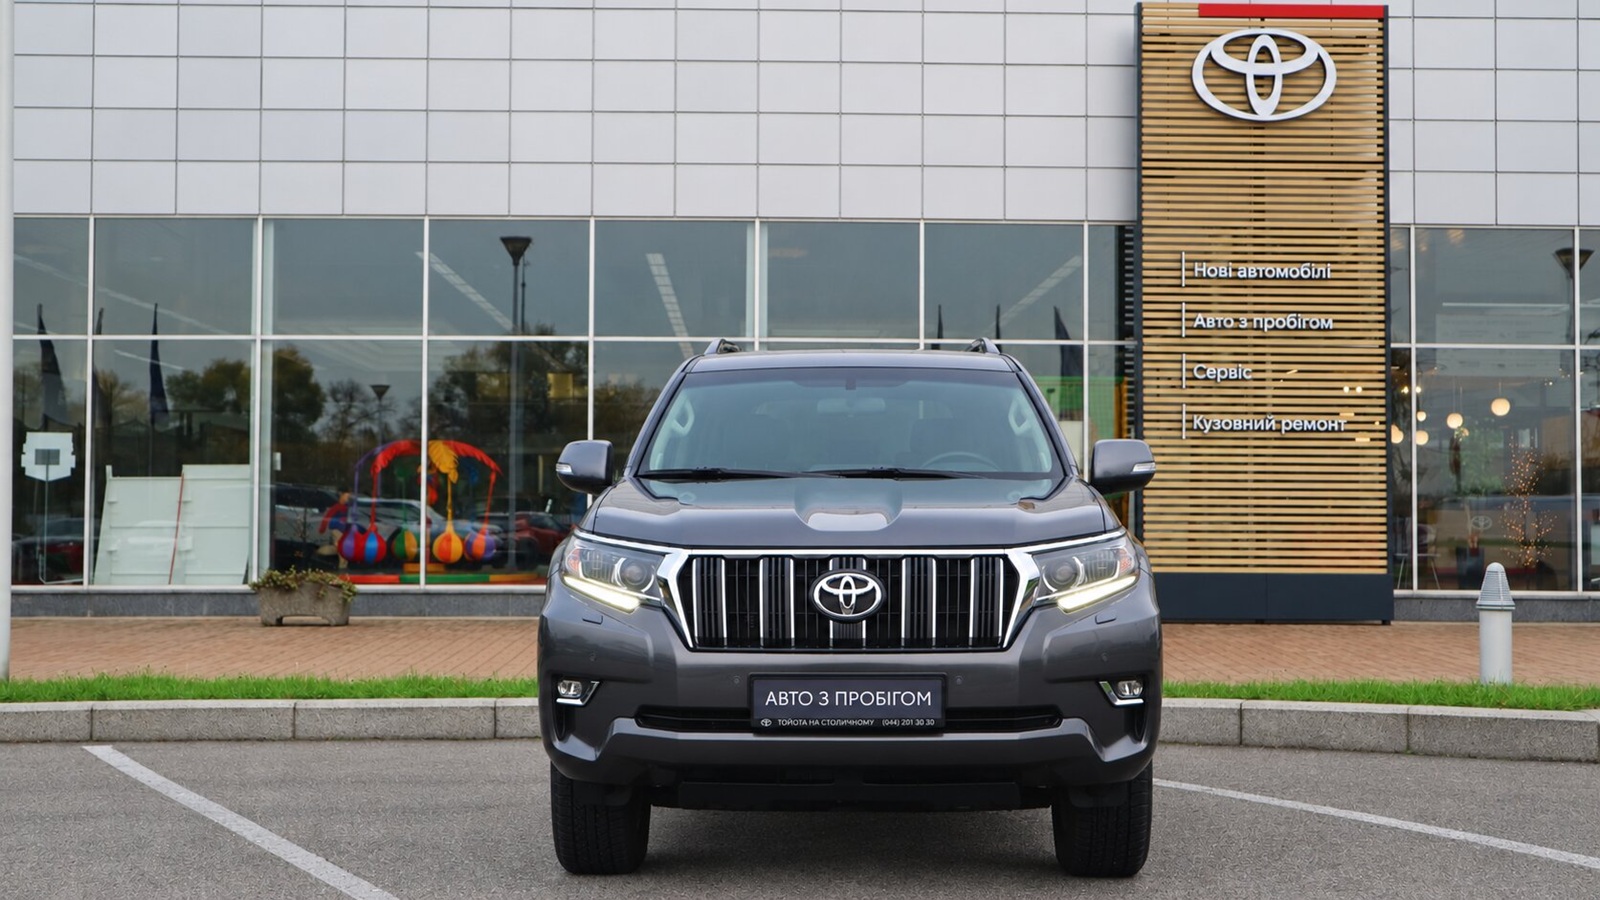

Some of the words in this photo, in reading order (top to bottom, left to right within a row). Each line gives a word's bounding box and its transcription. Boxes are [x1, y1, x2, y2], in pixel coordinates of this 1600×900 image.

[1194, 262, 1232, 278] Нові
[1237, 263, 1332, 279] автомобілі
[1193, 313, 1235, 329] Авто
[1238, 316, 1248, 329] з
[1253, 314, 1333, 332] пробігом
[1193, 364, 1252, 382] Сервіс
[1193, 415, 1276, 434] Кузовний
[1281, 418, 1348, 434] ремонт
[765, 691, 813, 706] АВТО
[835, 691, 932, 706] ПРОБІГОМ
[778, 718, 808, 726] ТОЙОТА
[882, 719, 900, 727] (044)
